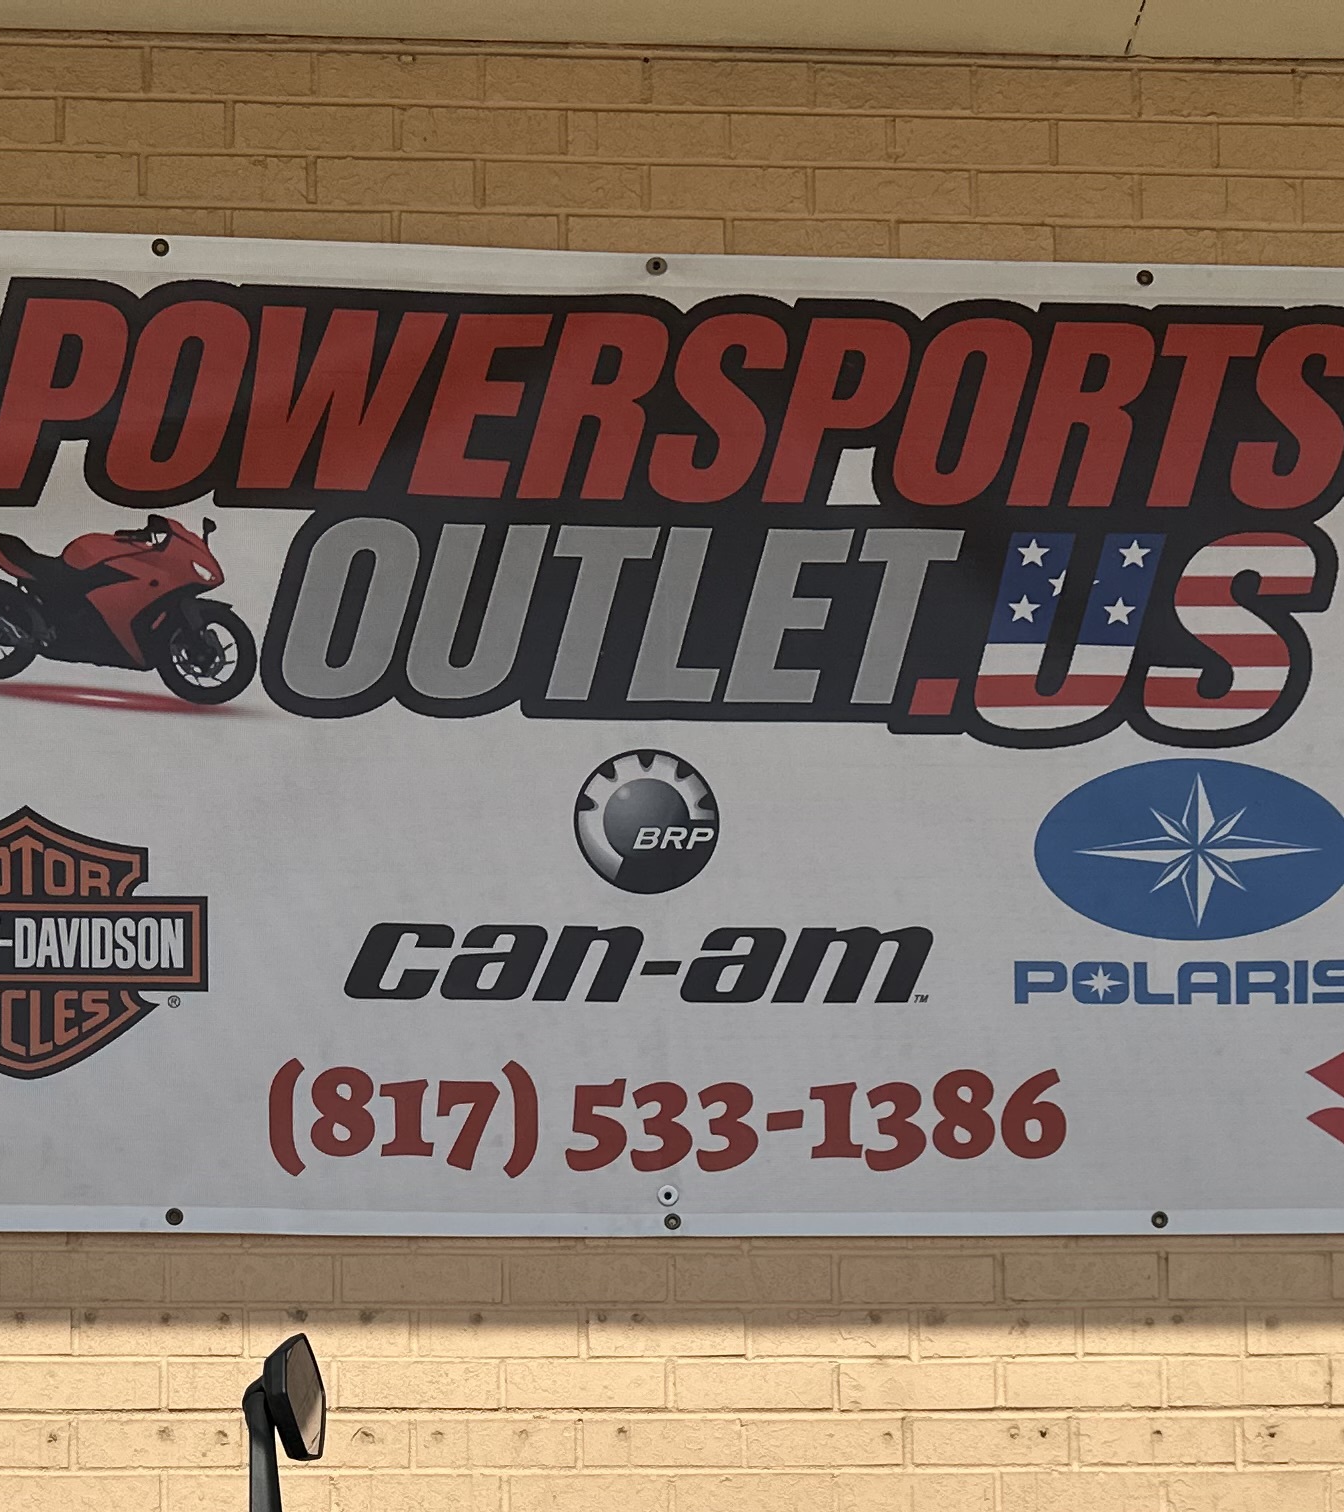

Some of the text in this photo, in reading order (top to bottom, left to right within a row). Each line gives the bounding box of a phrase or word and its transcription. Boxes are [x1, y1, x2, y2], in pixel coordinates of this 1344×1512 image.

[279, 515, 1320, 732] OUTLET.US
[632, 826, 716, 853] BRP
[268, 1057, 1068, 1179] (817) 533-1386
